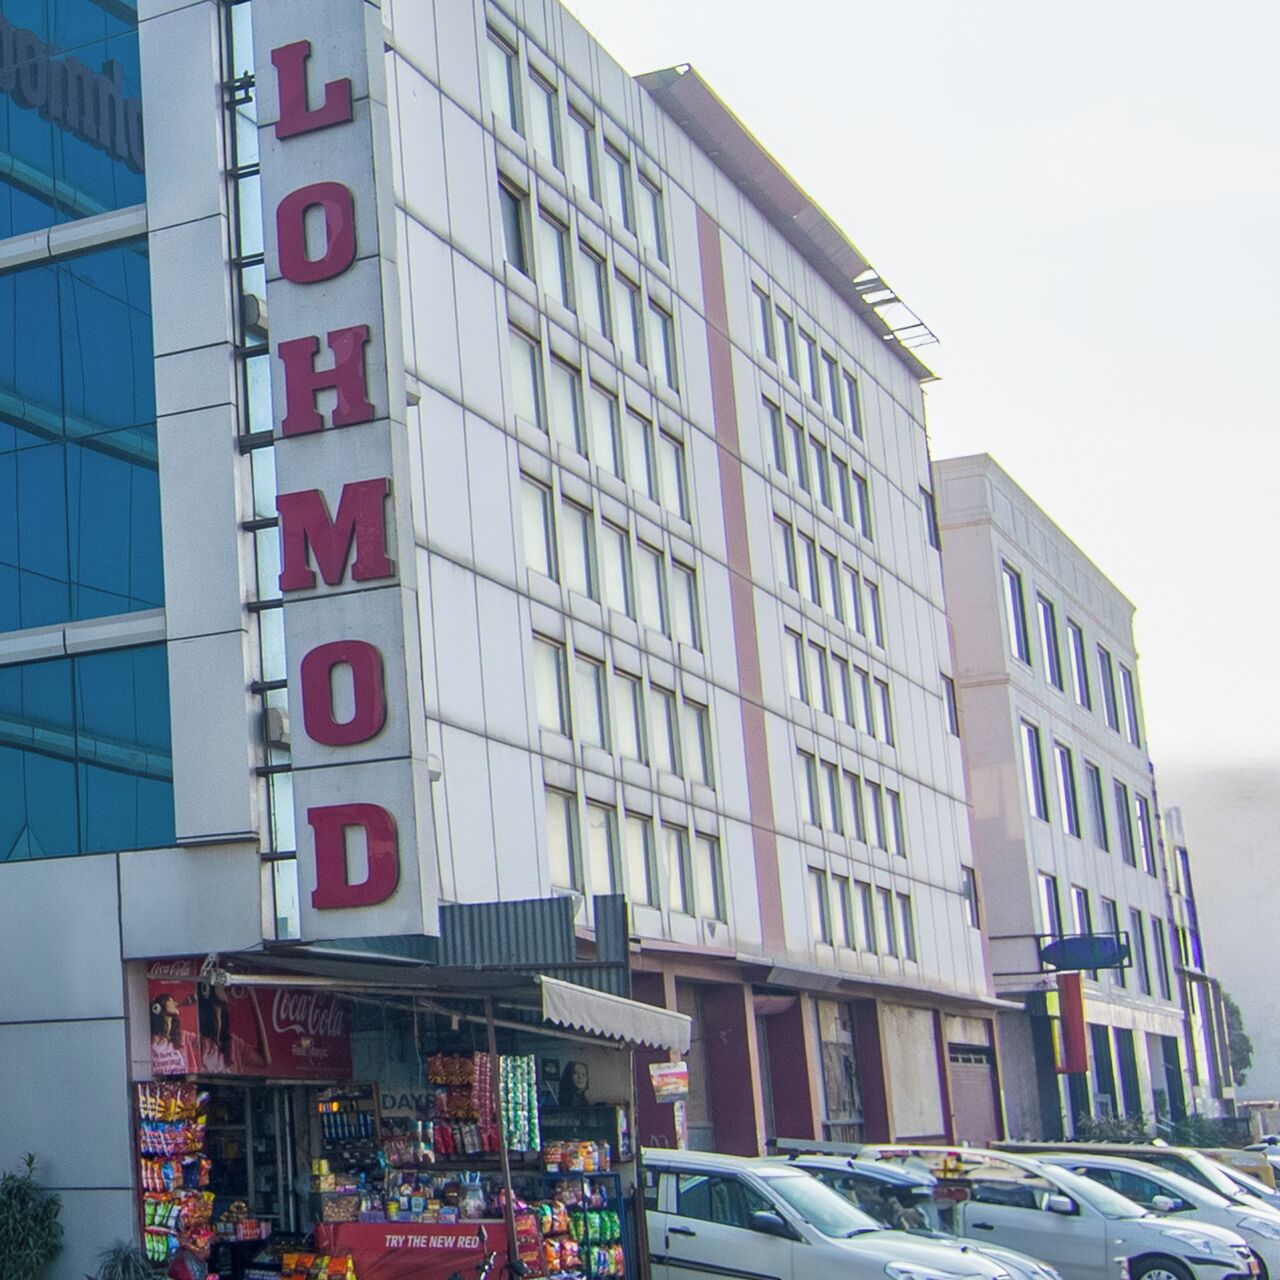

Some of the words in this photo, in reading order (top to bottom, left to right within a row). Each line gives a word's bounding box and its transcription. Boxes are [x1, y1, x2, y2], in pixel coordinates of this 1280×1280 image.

[270, 39, 402, 909] LOHMOD
[385, 1235, 405, 1247] TRY
[407, 1235, 428, 1248] THE
[429, 1235, 456, 1248] NEW
[457, 1236, 480, 1249] RED
